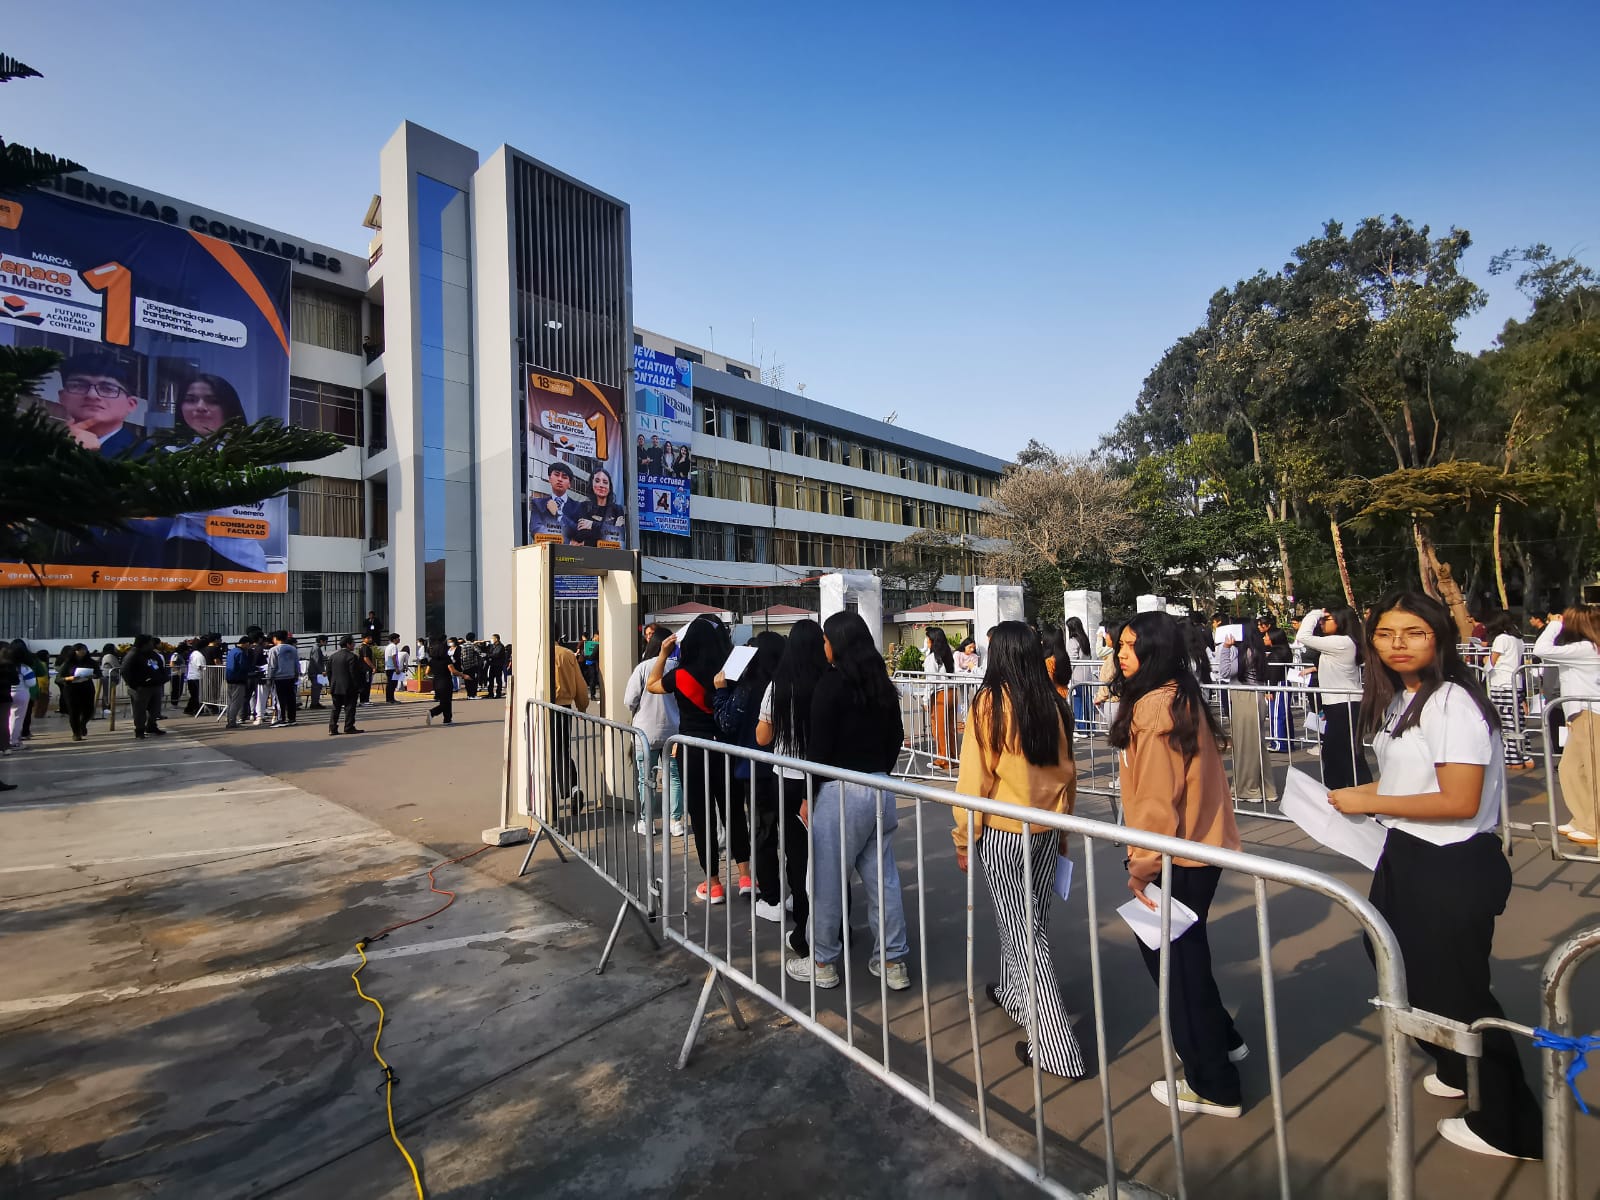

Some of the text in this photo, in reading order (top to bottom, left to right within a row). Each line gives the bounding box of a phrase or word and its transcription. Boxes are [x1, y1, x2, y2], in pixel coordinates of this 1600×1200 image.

[189, 215, 342, 273] CONTABLES
[32, 252, 72, 267] MARCA:
[0, 255, 72, 286] enace
[12, 275, 72, 297] Marcos
[46, 313, 95, 328] ACADÉMICO
[54, 308, 88, 320] FUTURO
[50, 320, 92, 334] CONTABLE
[142, 317, 197, 334] compromiso
[197, 329, 214, 338] que
[537, 376, 549, 389] 18
[634, 372, 677, 388] ONTABLE
[648, 475, 658, 483] DE
[233, 509, 264, 517] Guerrero
[220, 521, 255, 529] CONSEJO
